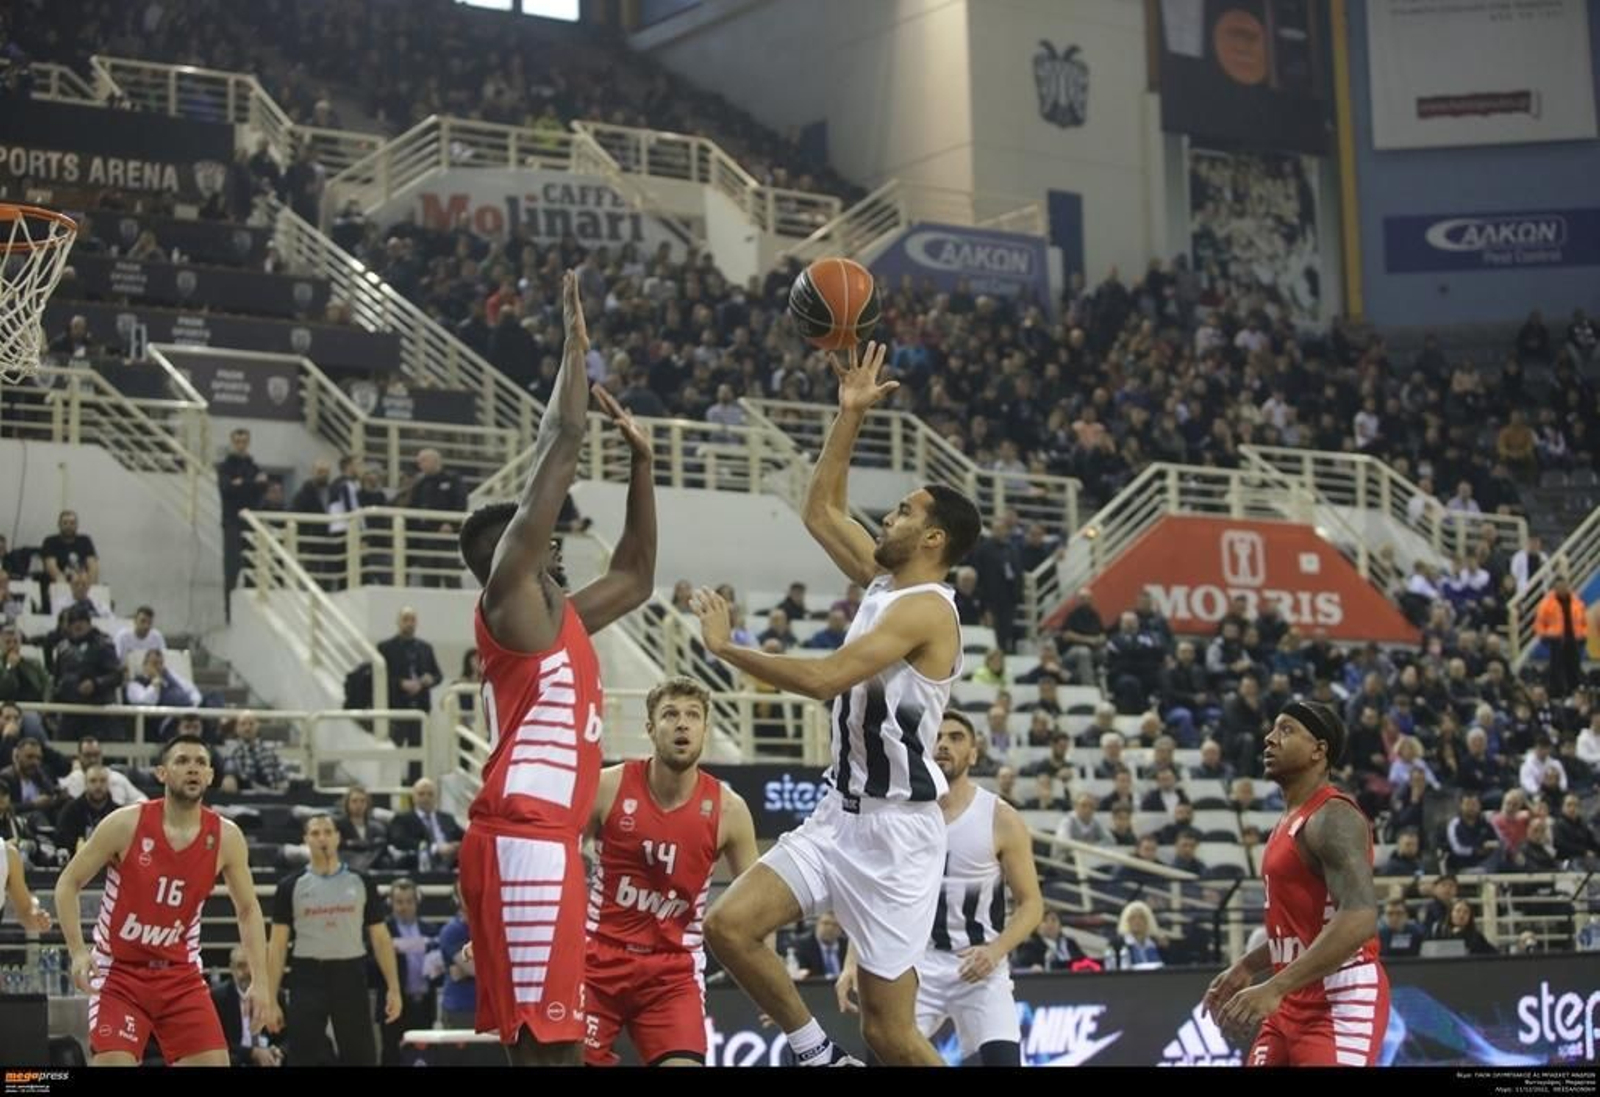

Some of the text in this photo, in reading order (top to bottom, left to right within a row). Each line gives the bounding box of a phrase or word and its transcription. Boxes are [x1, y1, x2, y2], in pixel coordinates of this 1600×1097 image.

[89, 156, 179, 192] ARENA
[418, 192, 644, 243] Molinari
[642, 840, 677, 875] 14
[156, 876, 185, 906] 16
[615, 875, 690, 920] bwin
[1026, 1005, 1106, 1056] NIKE
